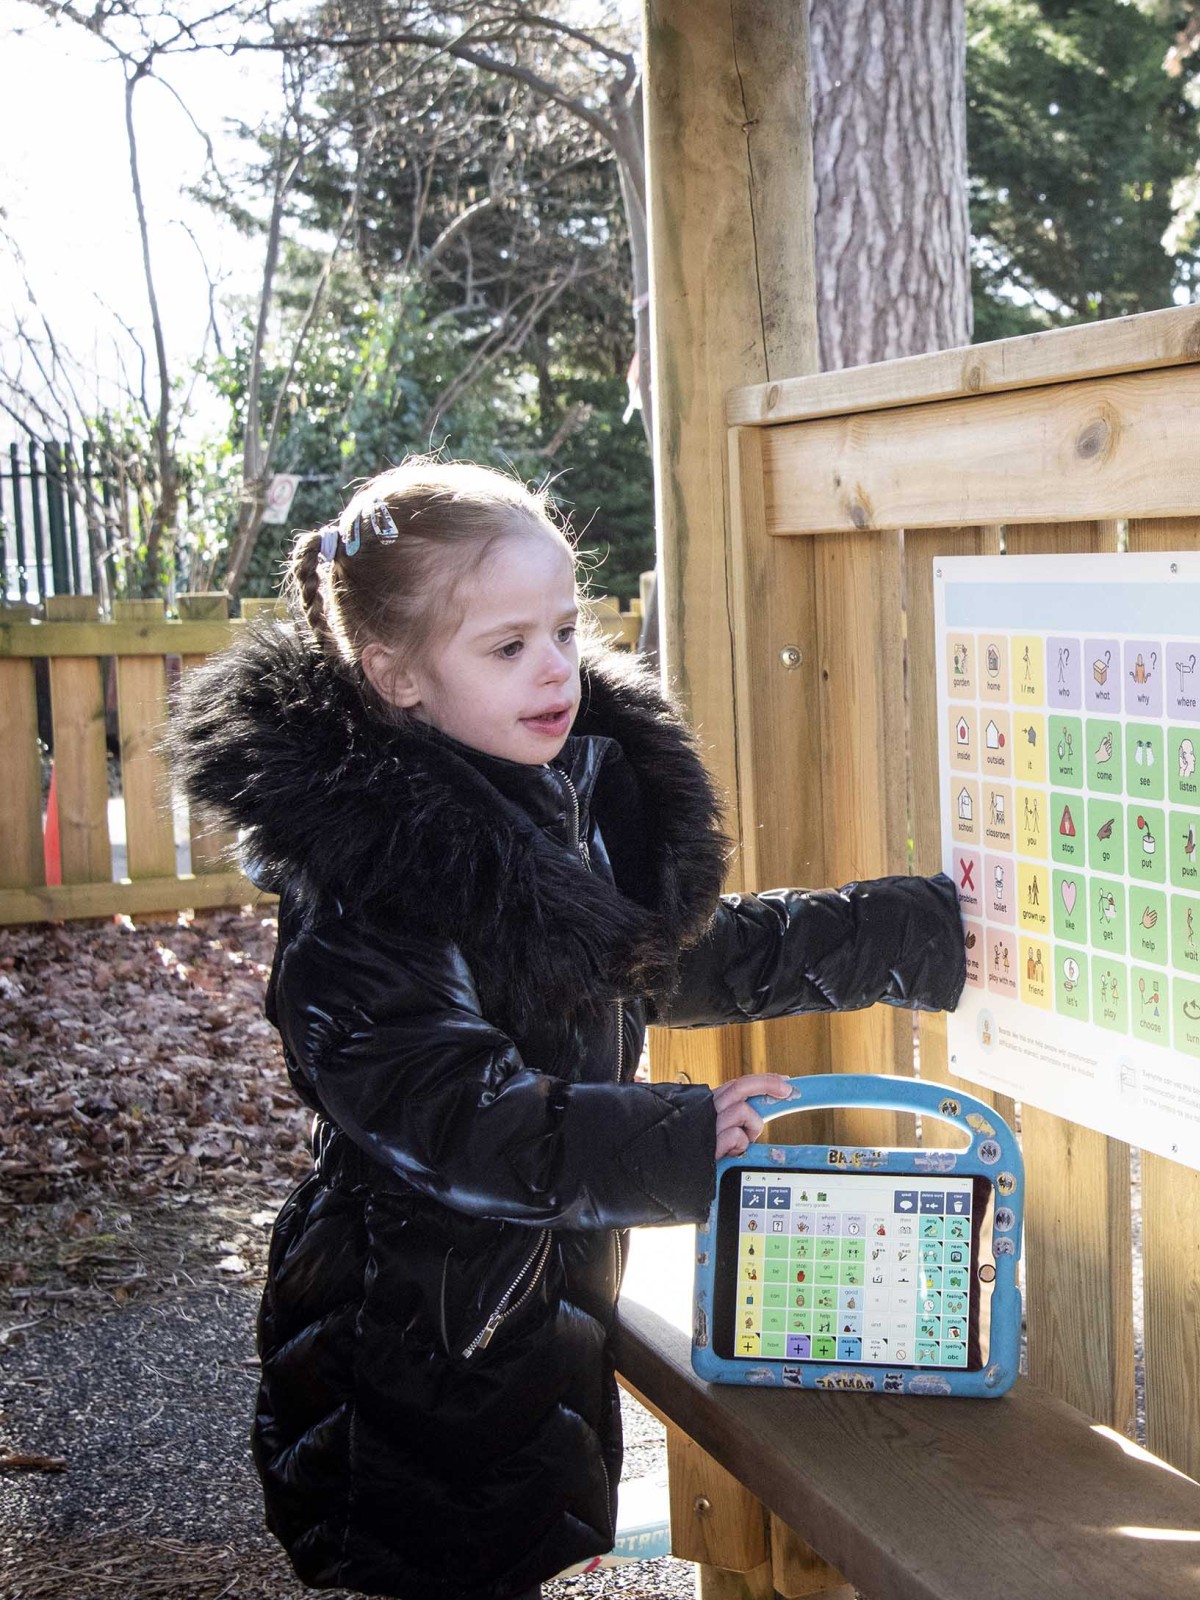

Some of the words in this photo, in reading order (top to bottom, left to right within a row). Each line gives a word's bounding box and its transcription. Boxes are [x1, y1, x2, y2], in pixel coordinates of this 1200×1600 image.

[953, 678, 970, 688] garden
[987, 681, 1001, 691] home
[1027, 686, 1035, 694] me
[1058, 687, 1070, 697] who
[1095, 690, 1110, 700] what
[1137, 694, 1150, 706] why
[1176, 696, 1196, 708] where
[956, 752, 971, 761] inside
[987, 756, 1005, 766] outside
[1027, 761, 1033, 770] it
[1059, 767, 1073, 775] want
[1096, 771, 1113, 781] come
[1139, 777, 1151, 786] see
[1179, 781, 1197, 792] listen
[958, 823, 973, 833] school
[986, 828, 1010, 840] classroom
[1027, 837, 1037, 846] you
[1062, 843, 1074, 854] stop
[1102, 851, 1111, 862] go
[1141, 859, 1152, 869] put
[1182, 867, 1198, 877] push
[993, 902, 1007, 913] toilet
[1022, 910, 1038, 920] grown
[1039, 915, 1046, 923] up
[1065, 919, 1075, 930] like
[1103, 930, 1114, 941] get
[1141, 938, 1156, 951] help
[1184, 950, 1199, 962] wait
[972, 960, 979, 968] me
[988, 973, 999, 984] play
[999, 977, 1009, 985] with
[1028, 983, 1044, 997] friend
[1066, 995, 1078, 1007] let's
[1103, 1008, 1117, 1021] play
[1139, 1019, 1161, 1033] choose
[1186, 1032, 1200, 1044] turn
